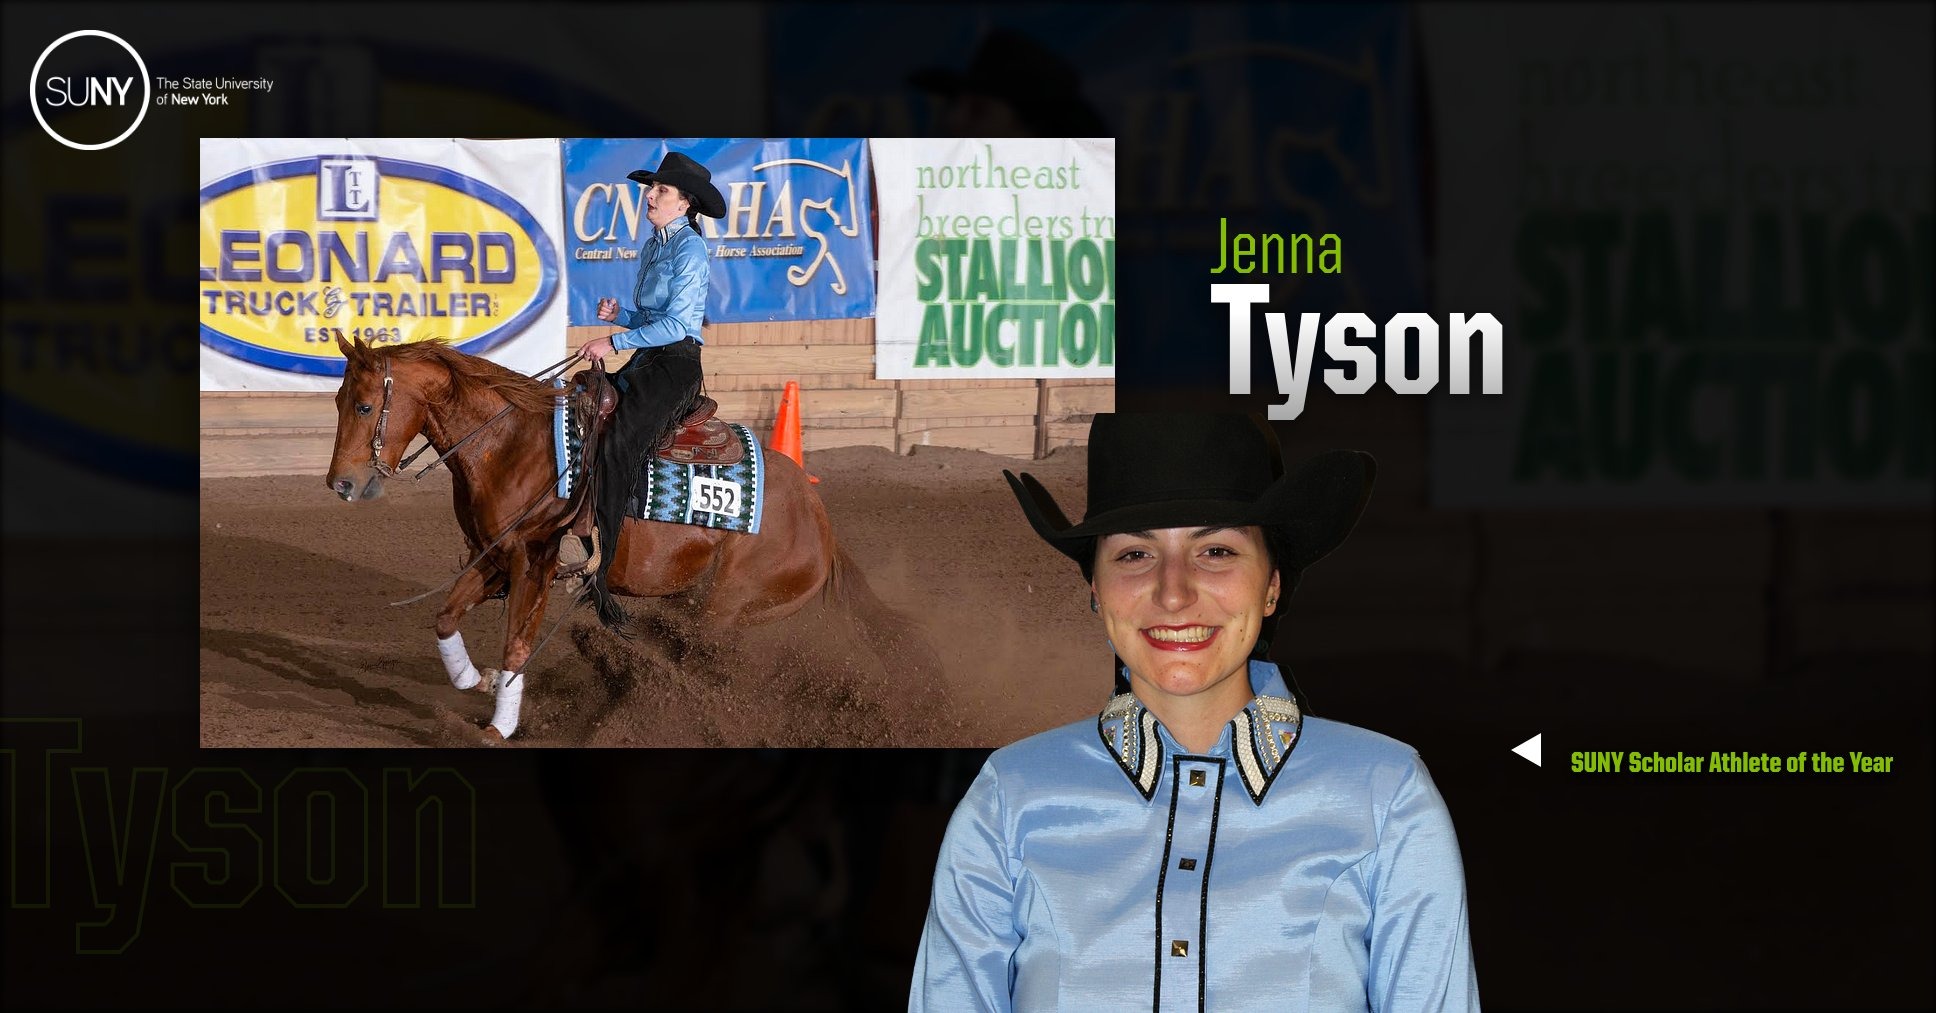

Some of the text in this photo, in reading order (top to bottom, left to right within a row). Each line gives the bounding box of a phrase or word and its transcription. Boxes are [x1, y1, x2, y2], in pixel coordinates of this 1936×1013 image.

[916, 144, 1081, 190] northeast
[573, 180, 796, 242] CNHA
[915, 194, 1073, 238] breeders
[575, 246, 638, 260] Central New
[715, 245, 747, 258] Horse
[749, 244, 804, 257] Association
[203, 290, 320, 316] TRUCK
[350, 292, 491, 317] TRAILER
[699, 484, 735, 514] 552
